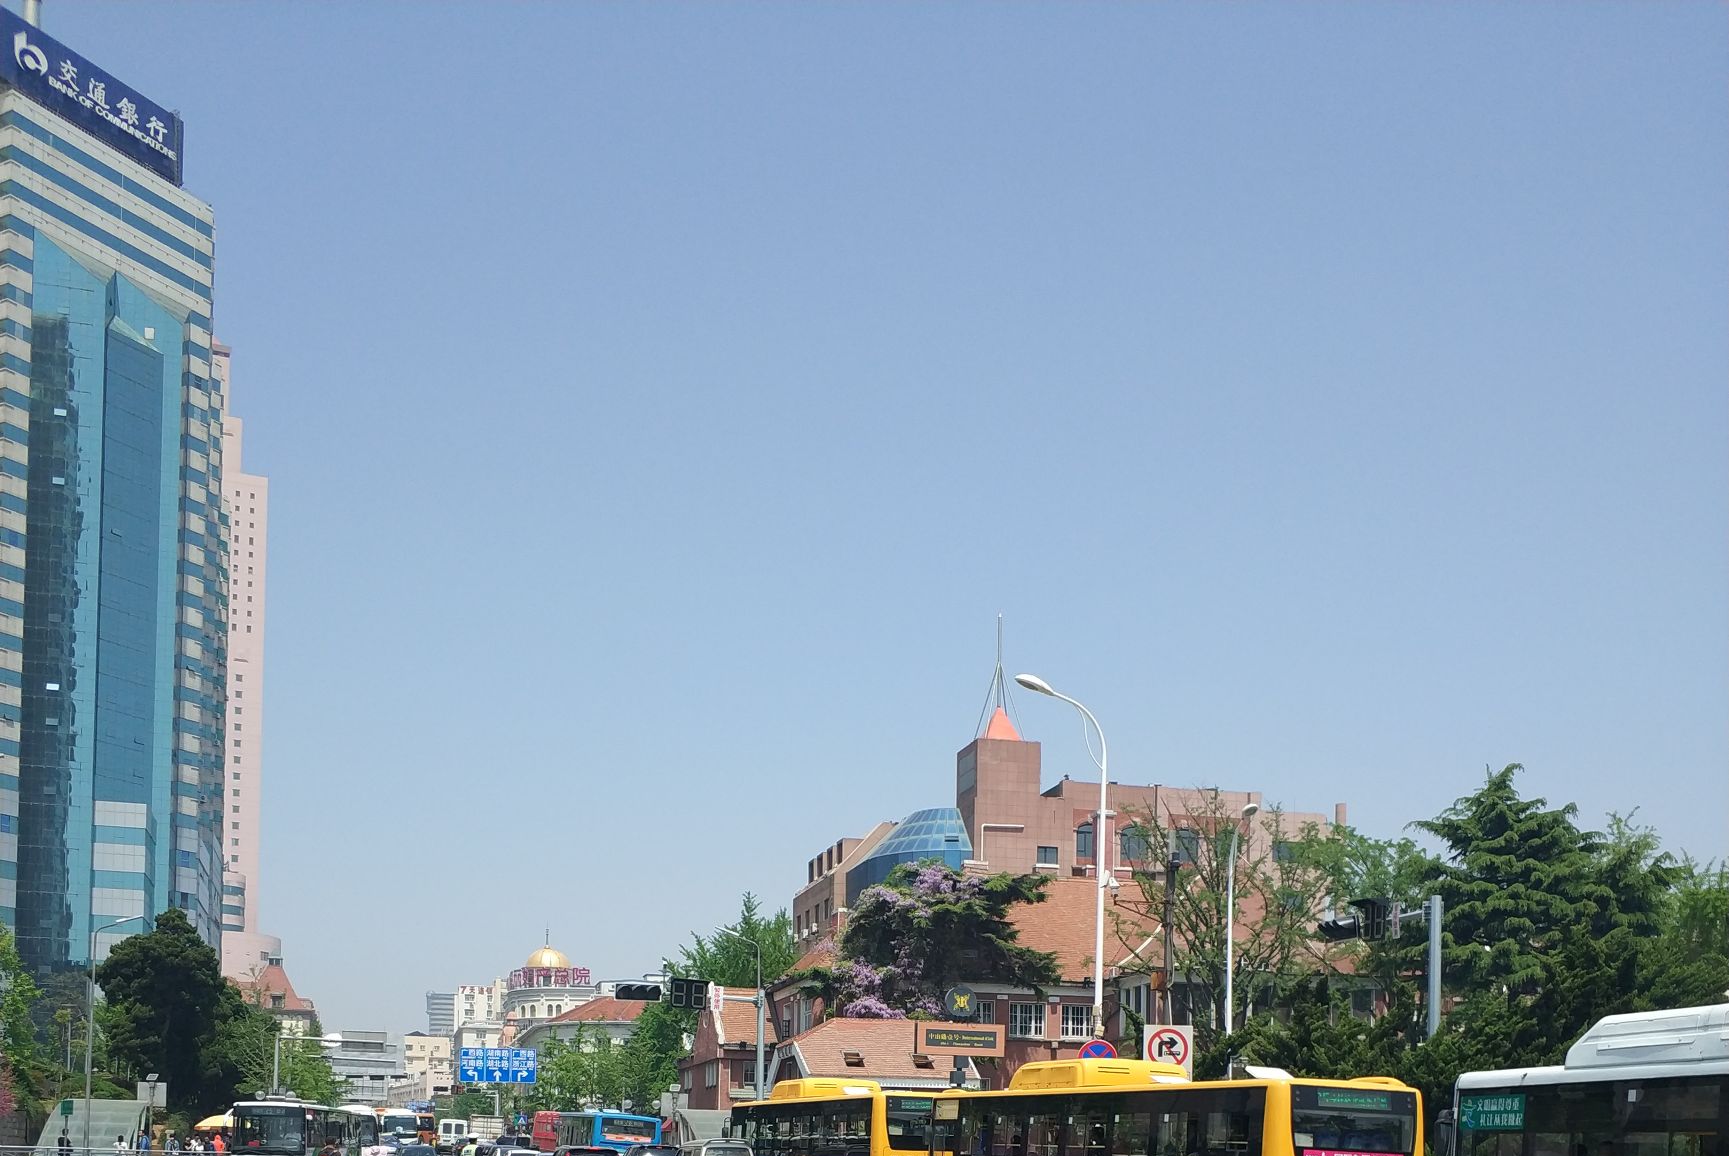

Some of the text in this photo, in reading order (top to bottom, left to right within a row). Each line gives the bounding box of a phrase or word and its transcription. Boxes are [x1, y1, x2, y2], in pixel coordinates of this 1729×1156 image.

[48, 75, 178, 161] BANK OF COMMUNICATIONS
[461, 1049, 484, 1057] 广西路
[486, 1049, 509, 1057] 湖南路
[512, 1050, 535, 1058] 广西路
[486, 1060, 509, 1068] 湖北路
[512, 1060, 535, 1068] 浙江路
[1476, 1097, 1520, 1111] 文明赢得尊重
[1479, 1112, 1523, 1127] 礼让从我做起
